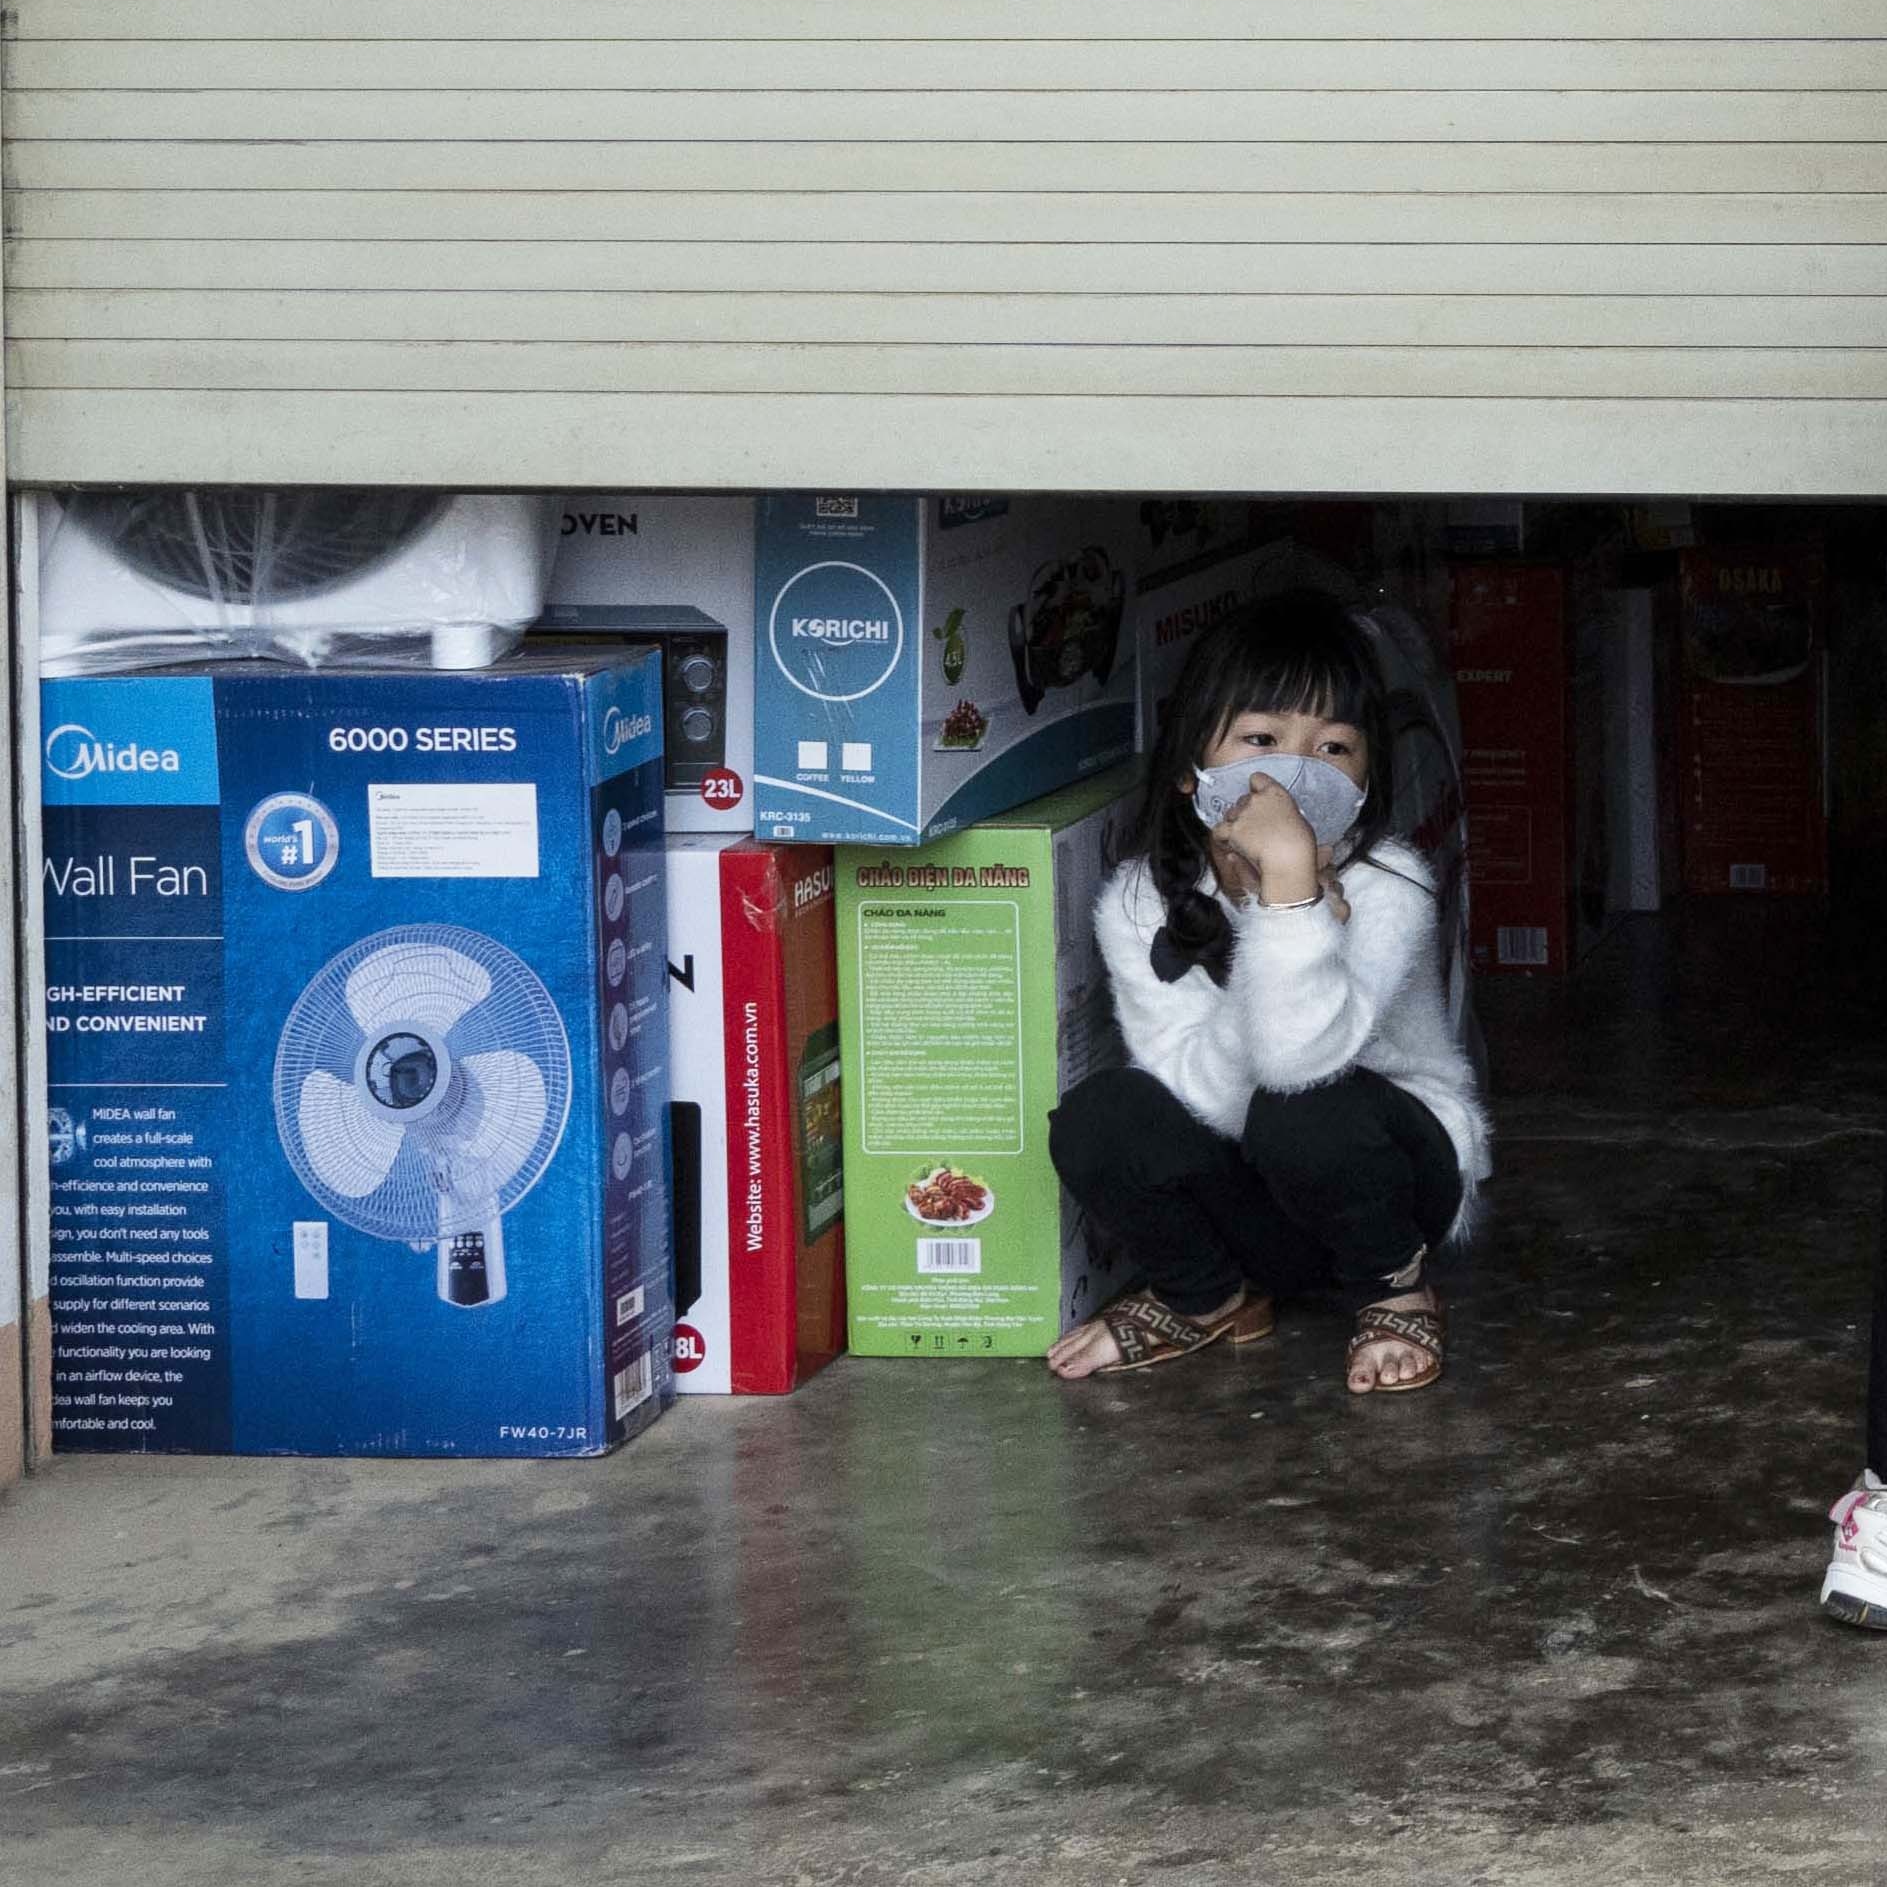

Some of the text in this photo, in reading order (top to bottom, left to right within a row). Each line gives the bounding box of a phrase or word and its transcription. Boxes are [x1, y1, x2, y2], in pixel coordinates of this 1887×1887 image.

[791, 618, 889, 640] KORICHI
[604, 706, 652, 755] Midea
[328, 727, 517, 752] 6000 SERIES
[54, 731, 180, 777] Midea
[703, 779, 741, 800] 23L
[263, 834, 298, 845] world's
[130, 857, 207, 896] Fan
[858, 862, 903, 888] CHẢO
[979, 863, 1030, 888] NĂNG
[76, 1015, 207, 1032] CONVENIENT
[92, 1109, 175, 1120] MIDEA wall fan
[743, 1001, 763, 1252] Website: www.hasuka.com.vn
[93, 1132, 193, 1144] creates a full-scale
[94, 1157, 212, 1169] cool atmosphere with
[117, 1180, 208, 1192] and convenience
[74, 1204, 186, 1217] with easy installation
[76, 1230, 97, 1240] you
[130, 1228, 158, 1239] need
[160, 1230, 180, 1240] any
[182, 1228, 209, 1240] tools
[106, 1252, 169, 1264] Multi-speed
[172, 1251, 213, 1263] choices
[60, 1275, 204, 1289] oscillation function provide
[53, 1299, 210, 1312] supply for different scenarios
[61, 1323, 214, 1336] widen the cooling area. With
[58, 1346, 211, 1360] functionality you are looking
[57, 1370, 183, 1383] in an airflow device, the
[74, 1394, 173, 1407] wall fan keeps you
[107, 1418, 128, 1429] and
[131, 1419, 156, 1429] cool.
[500, 1425, 587, 1441] FW40-7JR
